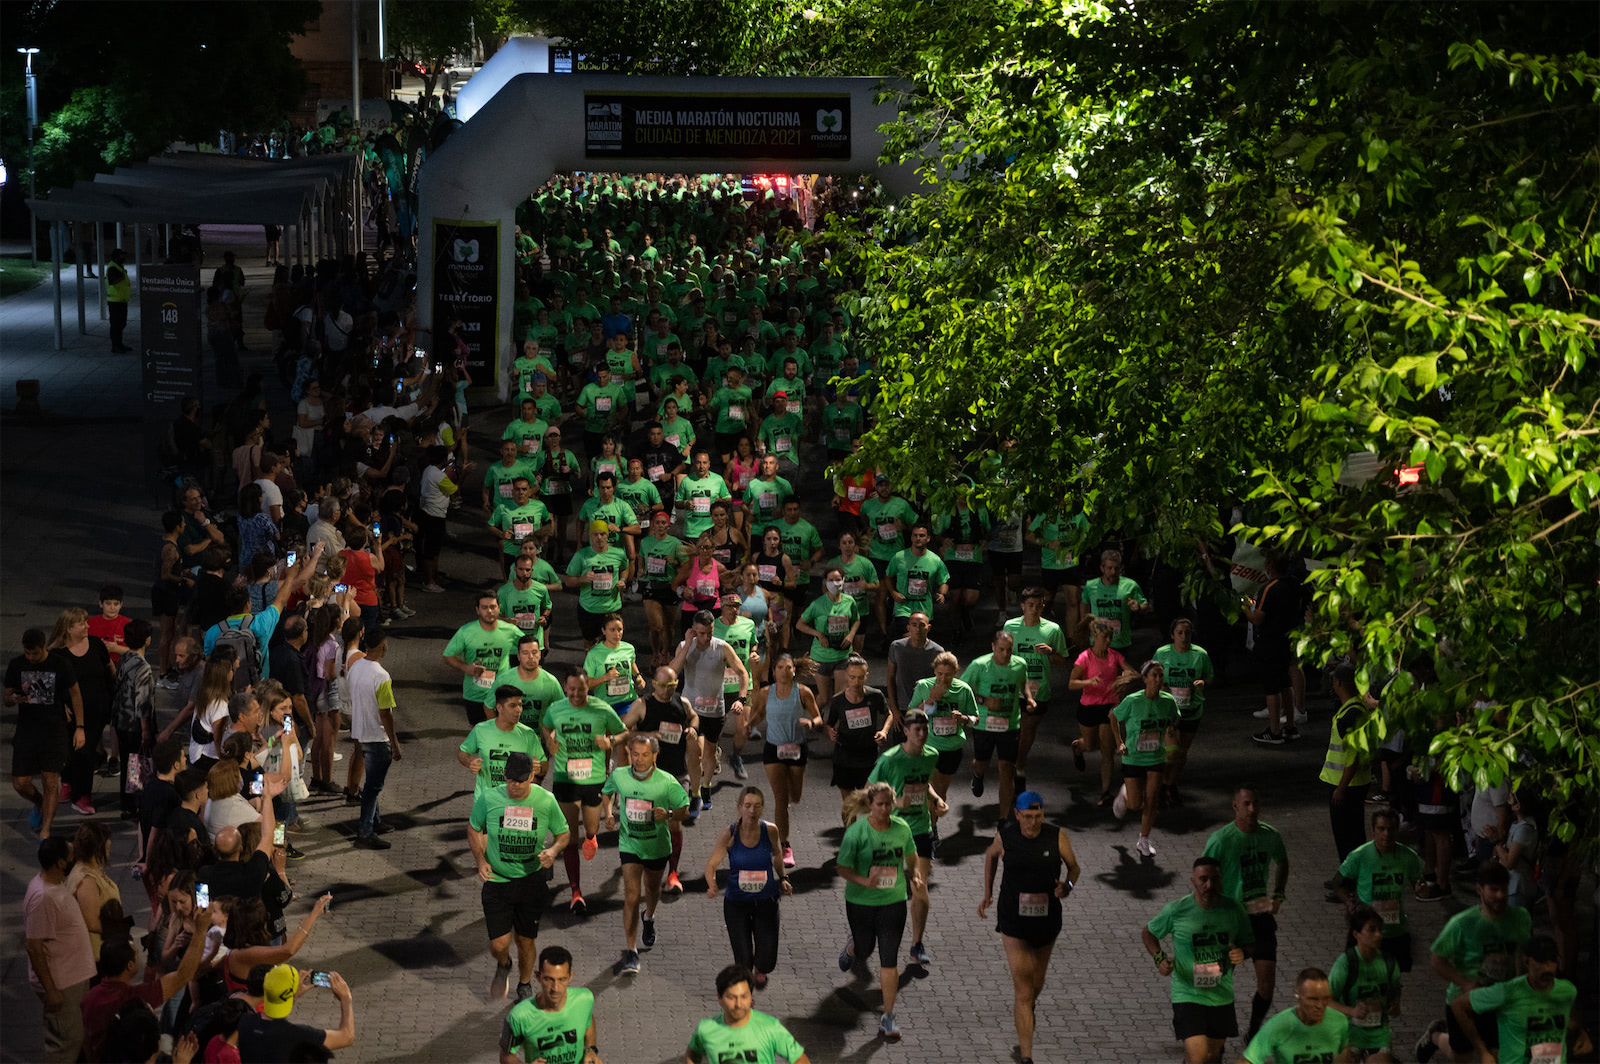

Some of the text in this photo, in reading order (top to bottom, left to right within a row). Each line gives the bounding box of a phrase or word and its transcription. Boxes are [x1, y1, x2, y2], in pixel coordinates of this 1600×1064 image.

[635, 110, 674, 126] MEDIA
[676, 108, 734, 126] MARATÓN
[737, 111, 800, 127] NOCTURNA
[635, 128, 801, 145] CIUDAD DE MENDOZA 2021
[810, 133, 848, 142] mendoza
[142, 277, 175, 285] Ventanilla
[160, 309, 178, 324] 148
[850, 718, 870, 728] 2490
[628, 810, 648, 820] 2161
[506, 818, 529, 828] 2298
[498, 834, 538, 844] MARATON
